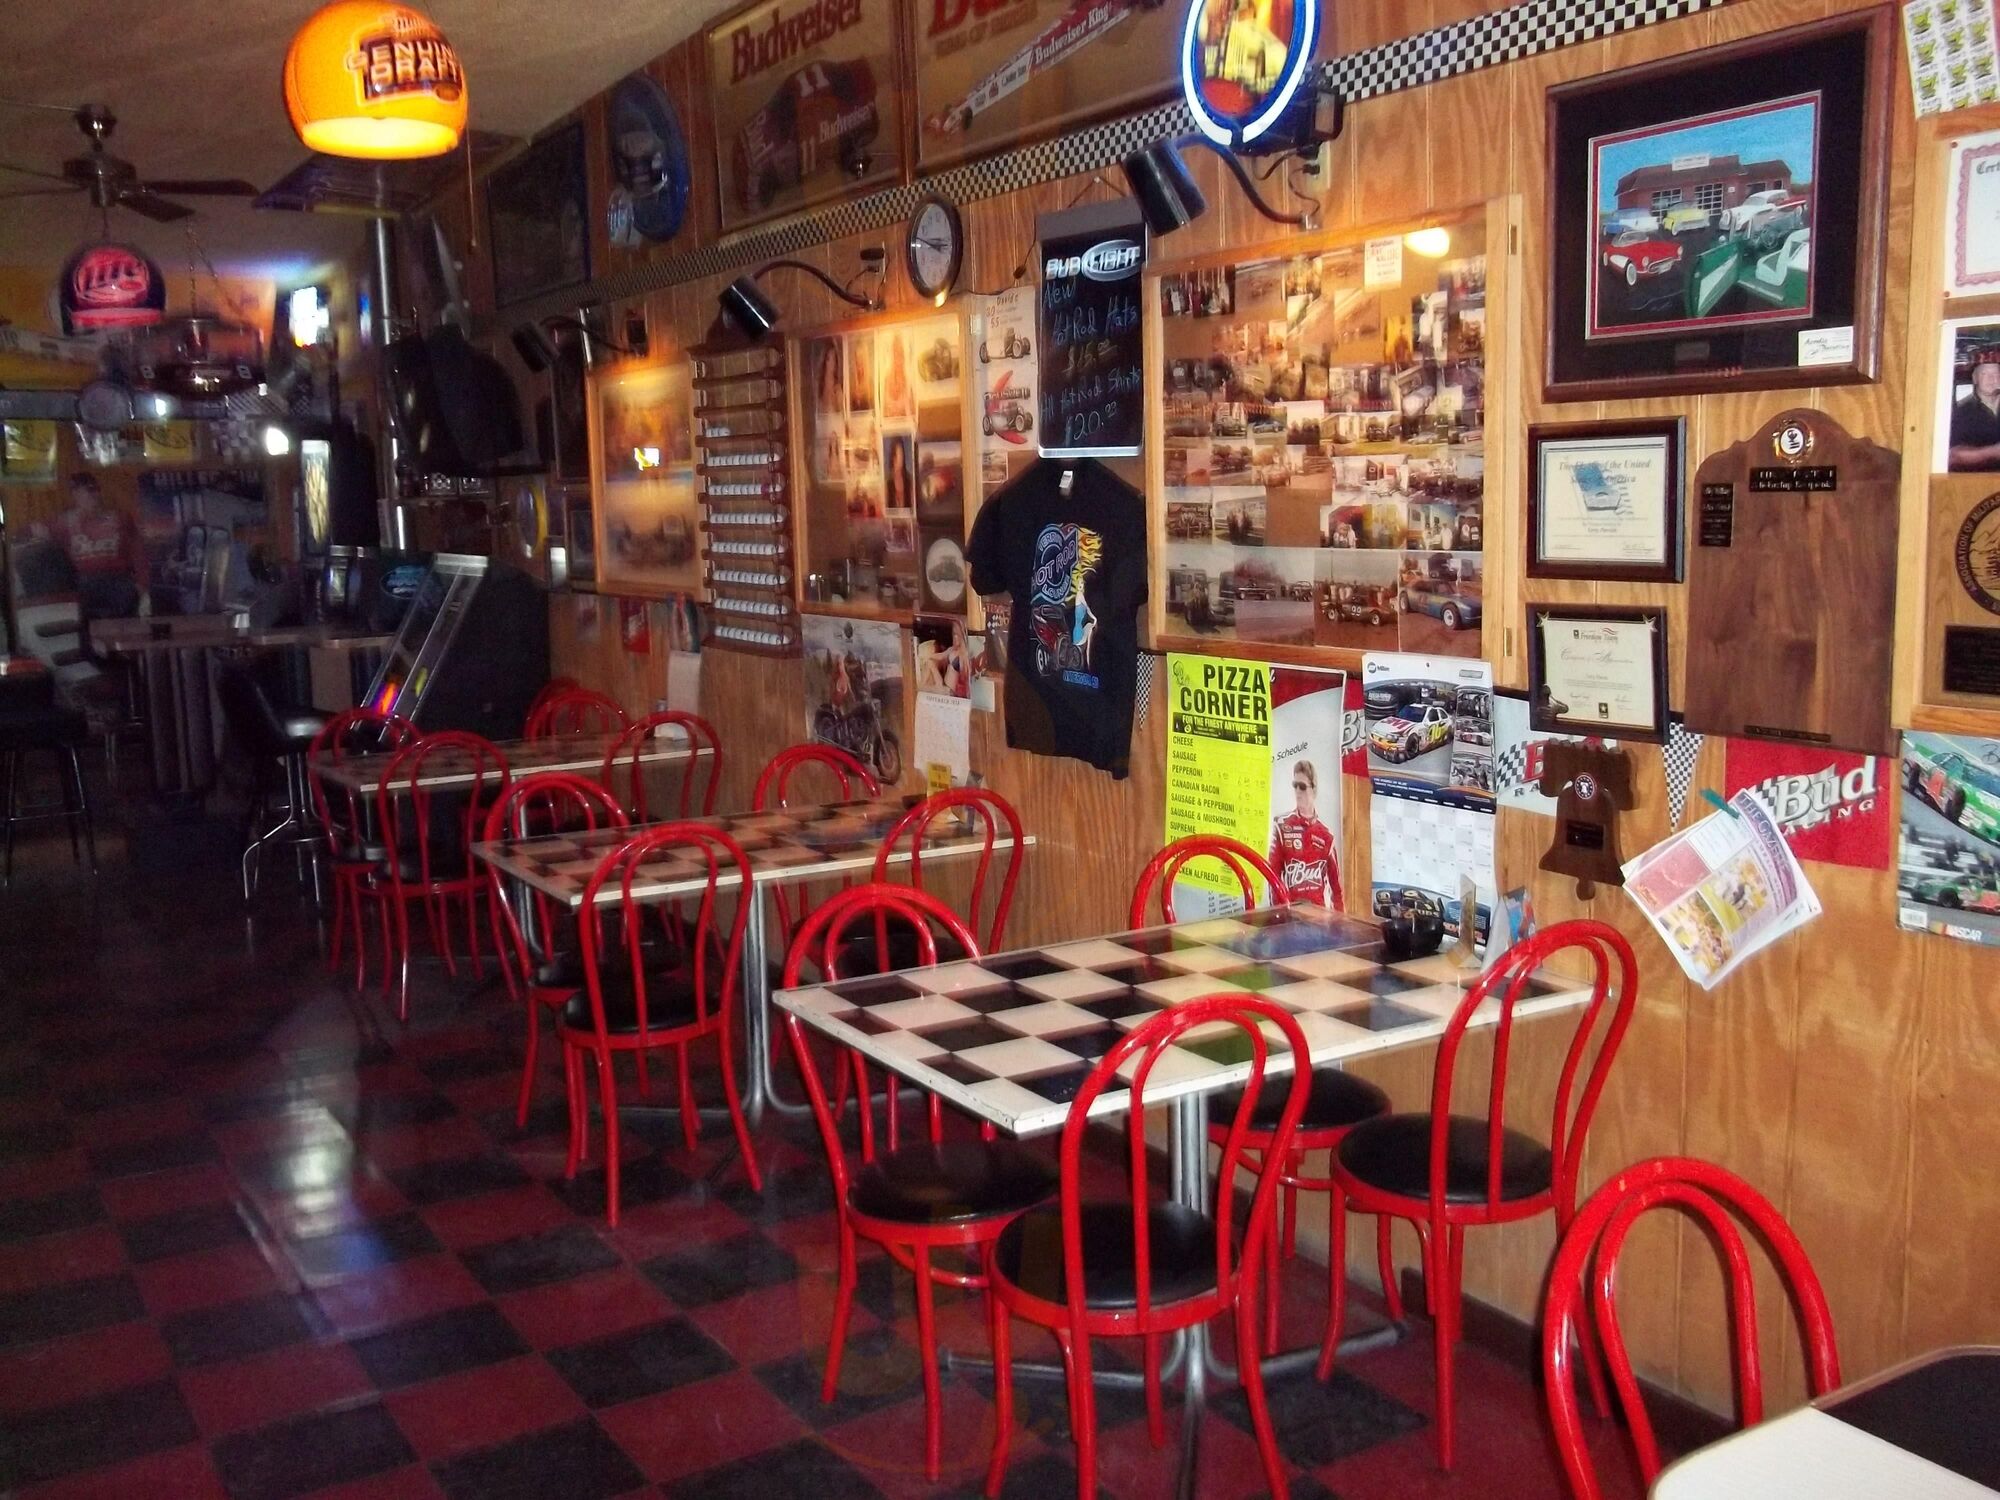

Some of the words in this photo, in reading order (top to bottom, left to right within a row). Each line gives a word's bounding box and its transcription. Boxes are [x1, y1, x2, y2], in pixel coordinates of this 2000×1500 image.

[731, 0, 862, 84] Budweiser
[1034, 20, 1087, 64] Budweiser
[1088, 4, 1112, 30] King
[346, 41, 458, 71] GENUIN
[1046, 256, 1081, 280] BUD
[1084, 246, 1140, 272] LIGHT
[1043, 276, 1077, 309] New
[1055, 540, 1076, 573] ROD
[1203, 663, 1267, 695] PIZZA
[1180, 686, 1268, 722] CORNER
[1182, 715, 1193, 724] FOR
[1194, 716, 1204, 727] THE
[1204, 718, 1223, 729] FINEST
[1224, 721, 1258, 734] ANYWHERE
[1172, 735, 1194, 747] CHEESE
[1277, 741, 1309, 761] Schedule
[1172, 750, 1197, 762] SAUSAGE
[1172, 764, 1203, 777] PEPPERONI
[1171, 779, 1200, 792] CANADIAN
[1201, 785, 1220, 795] BACON
[1776, 755, 1875, 824] Bud
[1171, 793, 1196, 806] SAUSAGE
[1203, 800, 1235, 813] PEPPERONI
[1170, 807, 1195, 820] SAUSAGE
[1203, 813, 1236, 827] MUSHROOM
[1170, 821, 1196, 834] SUPREME
[1783, 799, 1873, 836] ACING
[1194, 869, 1219, 882] ALFREDO
[1286, 860, 1324, 885] Bud
[1946, 922, 1982, 942] NASCAR
